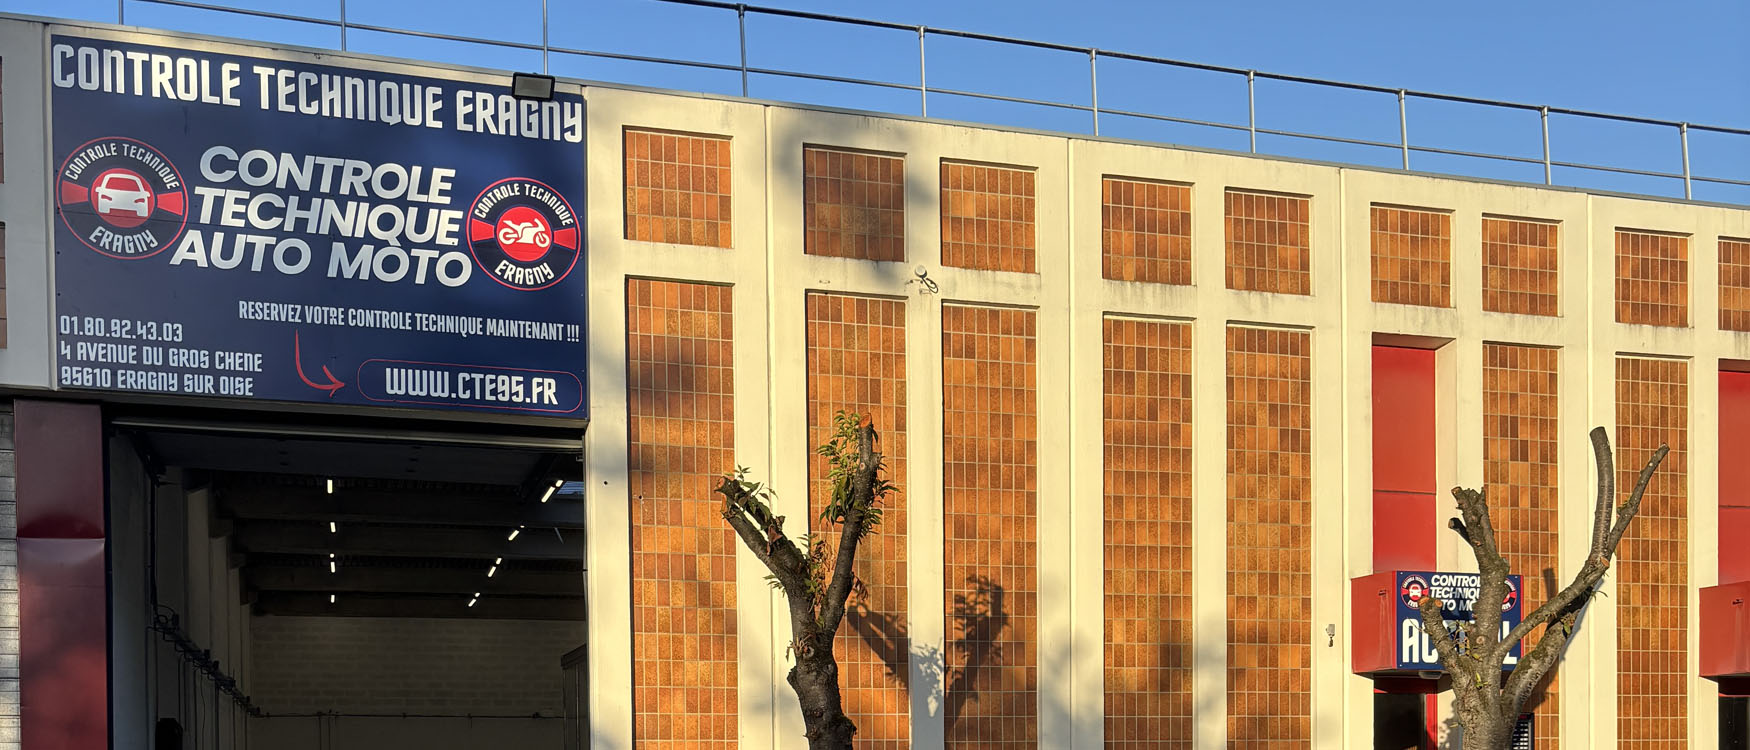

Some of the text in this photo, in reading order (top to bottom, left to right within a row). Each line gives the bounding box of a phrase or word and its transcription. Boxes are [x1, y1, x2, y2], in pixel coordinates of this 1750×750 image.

[53, 43, 583, 143] CONTROLE TECHNIQUE ERAGNY
[65, 142, 180, 190] CONTROLE TECHNIQUE
[200, 145, 456, 205] CONTROLE
[194, 186, 464, 247] TECHNIQUE
[474, 183, 574, 226] CONTROLE TECHNIQUE
[89, 225, 158, 254] ERAGNY
[169, 229, 473, 287] AUTO MOTO
[494, 259, 555, 286] ERAGNY
[60, 315, 183, 342] 01.80.92.43.03
[238, 300, 580, 343] RESERVEZ VOTRE CONTROLE TECHNIQUE MAINTENANT !!!
[60, 341, 263, 373] 4 AVENUE DU GROS CHENE
[61, 366, 254, 396] 95610 ERAGNY SUR OISE
[385, 367, 558, 405] WWW.CTE95.FR
[1431, 574, 1480, 587] CONTROL
